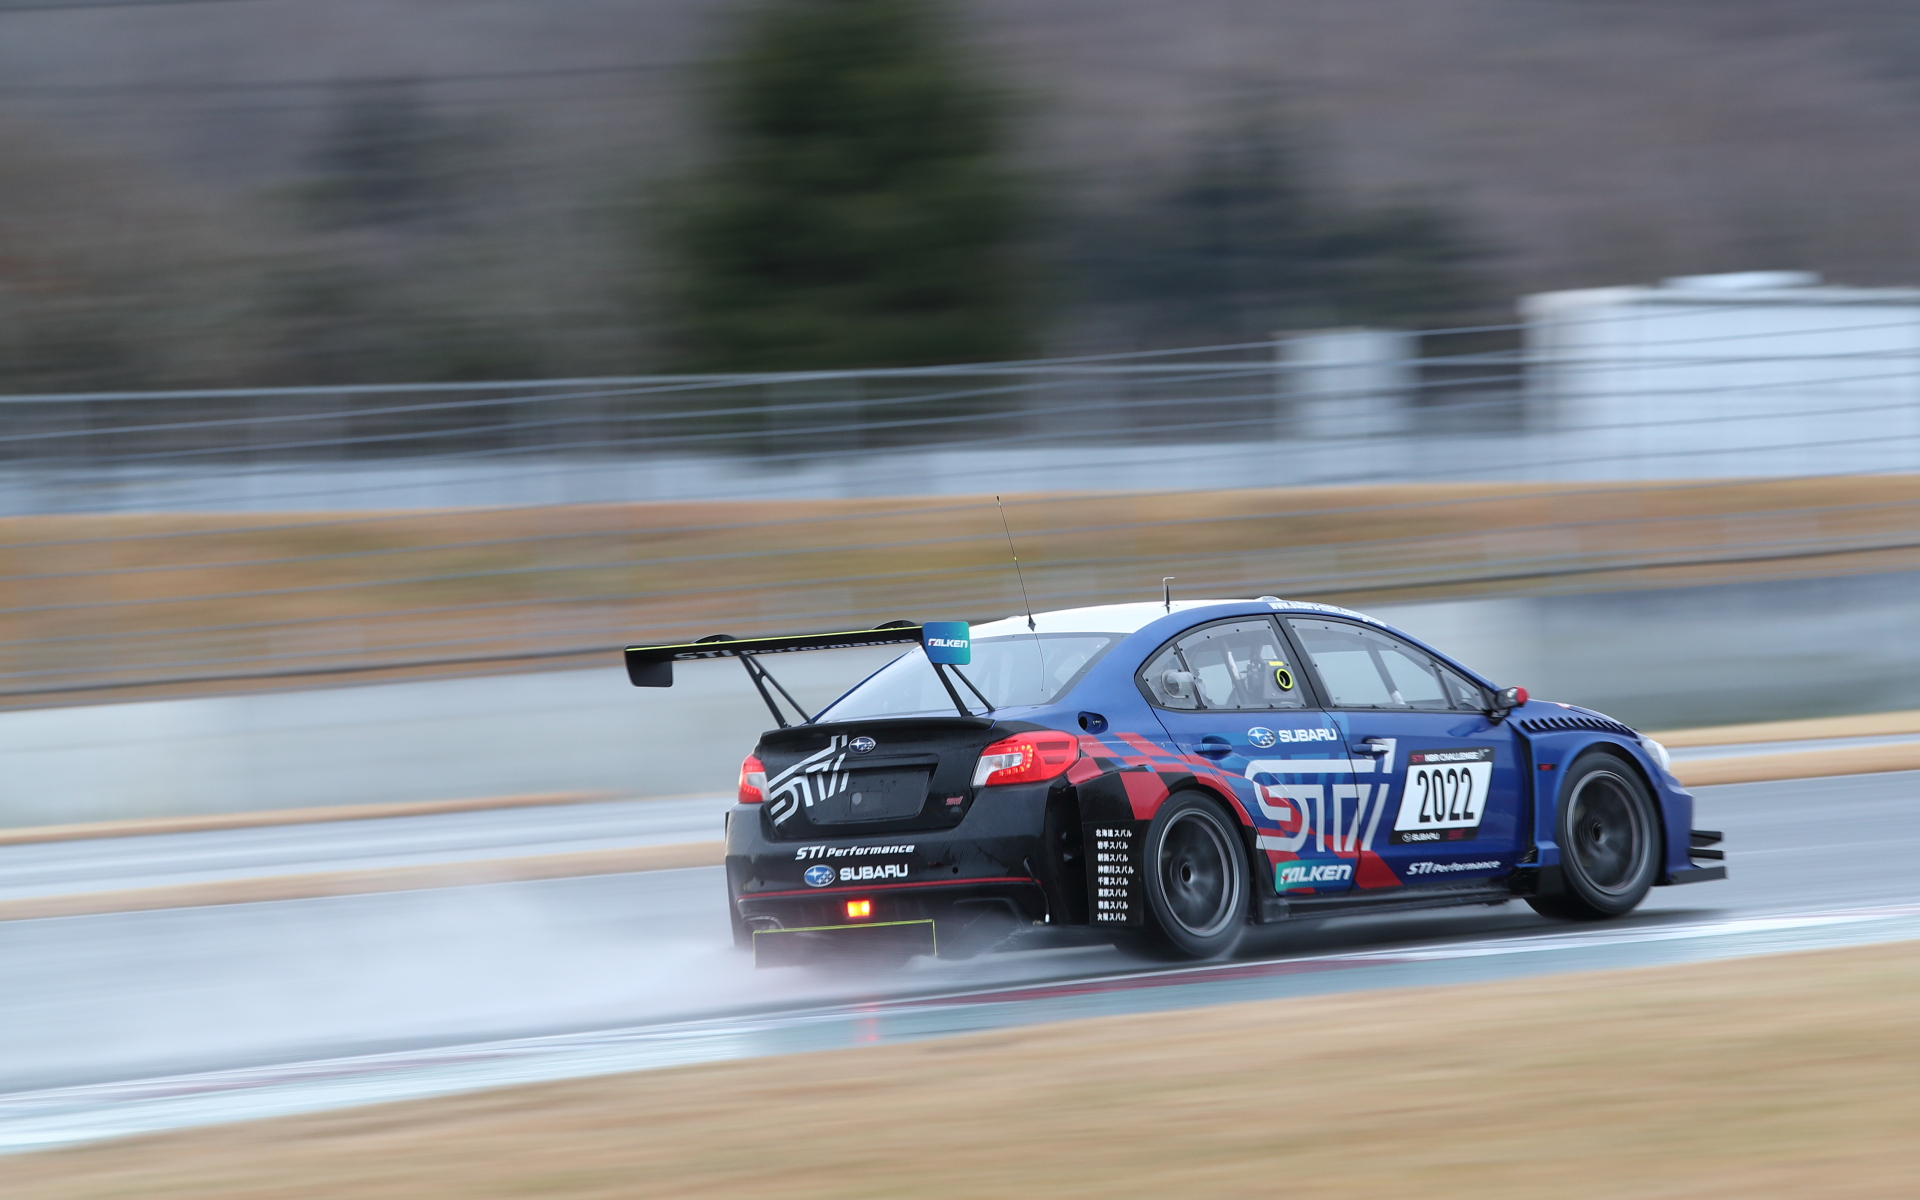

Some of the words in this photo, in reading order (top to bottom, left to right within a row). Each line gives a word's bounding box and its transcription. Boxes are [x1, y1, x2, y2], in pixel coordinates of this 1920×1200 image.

[928, 638, 968, 648] FALKEN
[674, 649, 732, 661] STI
[1279, 728, 1337, 743] SUBARU
[1424, 753, 1440, 763] NBR
[1440, 751, 1479, 761] CHALLENGE
[1244, 738, 1397, 852] STI
[1417, 767, 1475, 823] 2022
[1095, 828, 1132, 837] 北海道スバル
[1411, 832, 1440, 841] SUBARU
[1097, 841, 1128, 850] 岩手スバル
[795, 845, 826, 860] STI
[826, 844, 915, 858] Performance
[840, 864, 908, 881] SUBARU
[1097, 865, 1134, 874] 神奈川スバル
[1406, 861, 1434, 875] STI
[1431, 861, 1501, 873] Performance
[1280, 864, 1352, 885] FALKEN
[1098, 877, 1128, 885] 千葉スバル
[1098, 888, 1127, 898] 東京スバル
